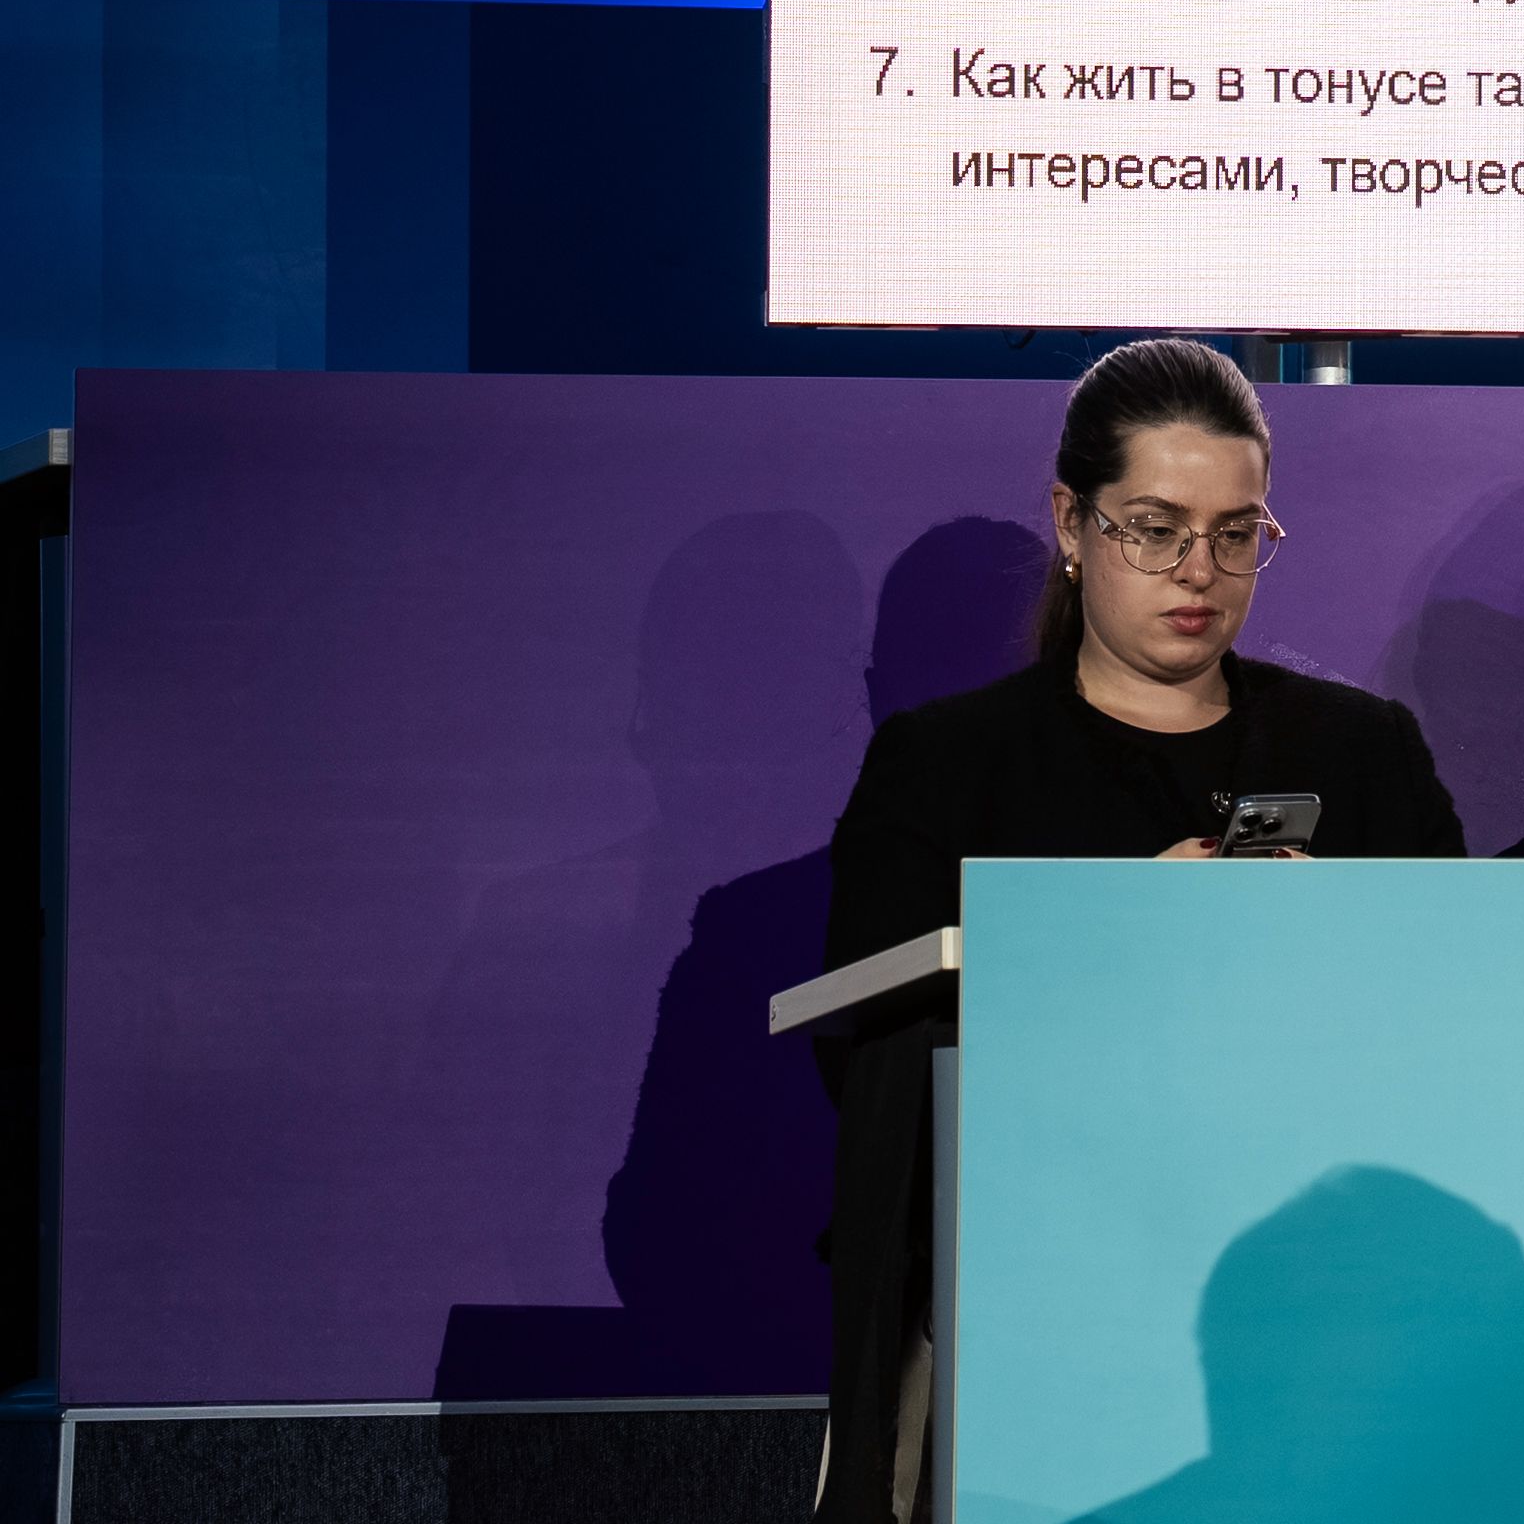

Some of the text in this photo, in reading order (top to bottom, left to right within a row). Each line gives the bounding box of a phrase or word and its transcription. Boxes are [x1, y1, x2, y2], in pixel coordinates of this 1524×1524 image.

[868, 44, 915, 98] 7.
[950, 46, 1048, 101] Как
[1062, 62, 1198, 104] жить
[1216, 65, 1247, 104] в
[1264, 65, 1449, 119] тонусе
[950, 150, 1301, 204] интересами,
